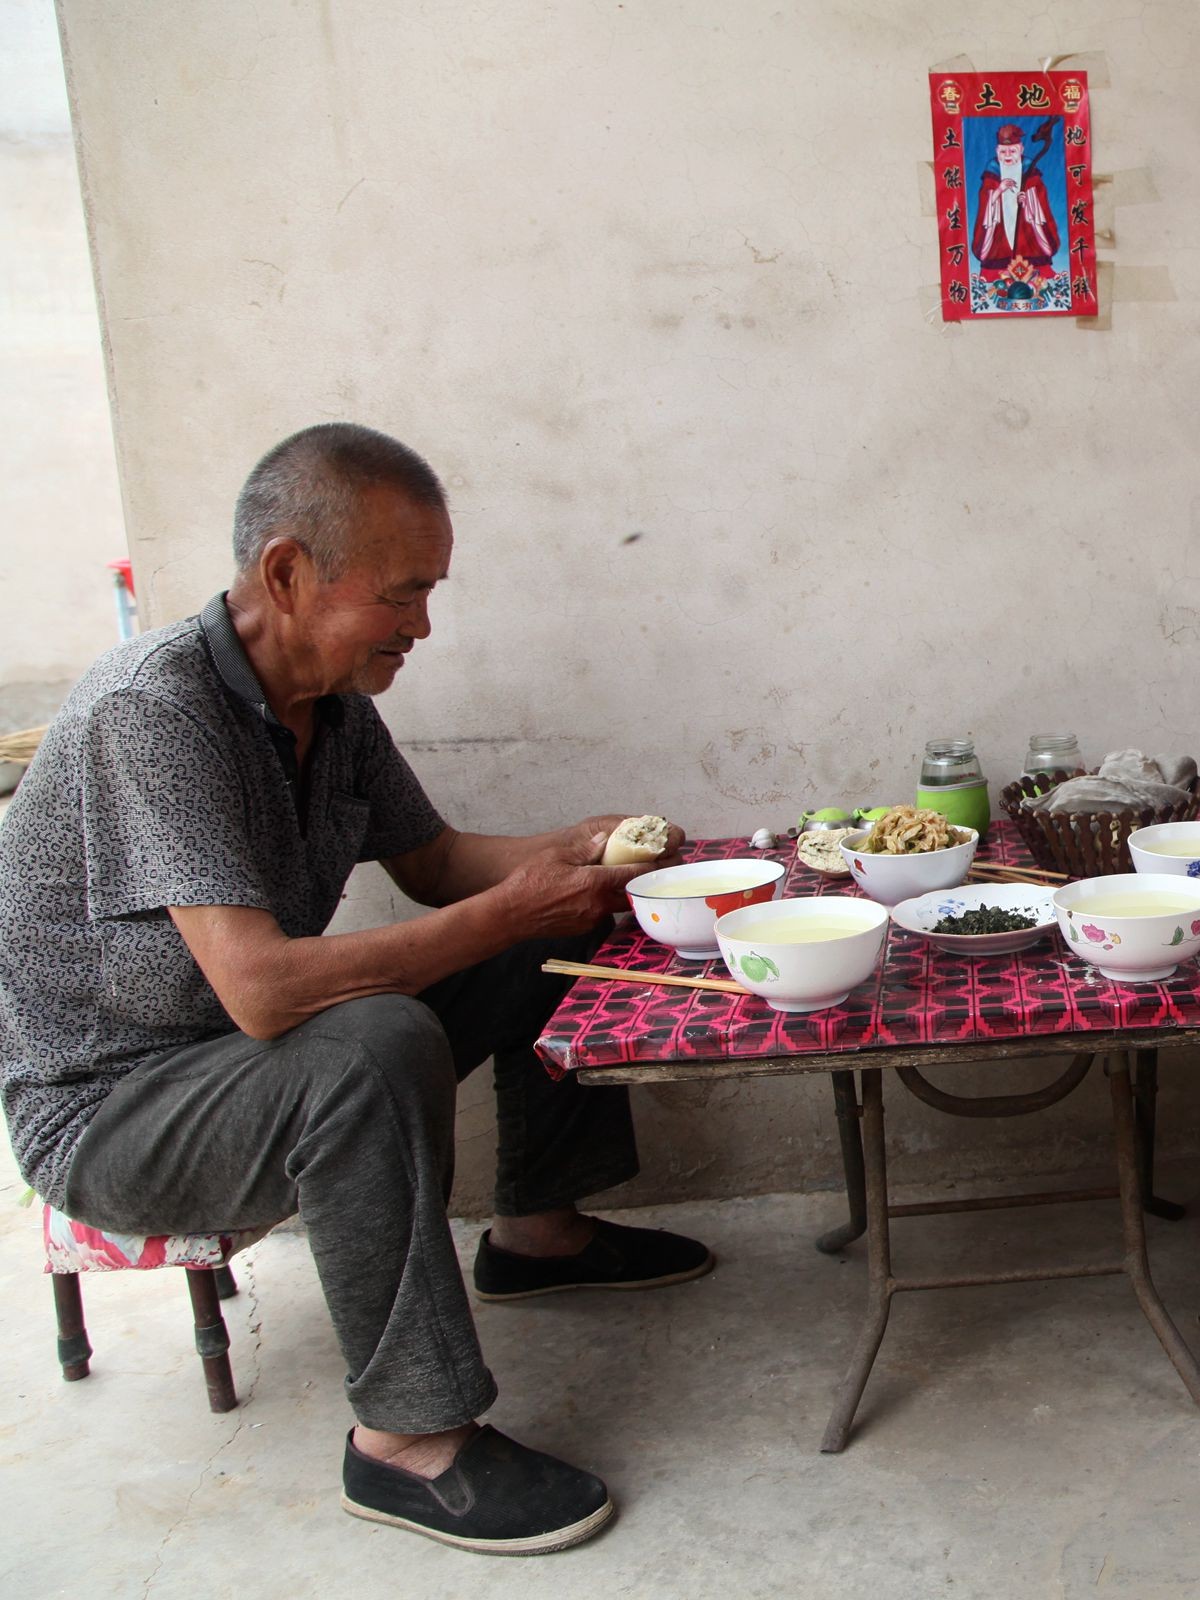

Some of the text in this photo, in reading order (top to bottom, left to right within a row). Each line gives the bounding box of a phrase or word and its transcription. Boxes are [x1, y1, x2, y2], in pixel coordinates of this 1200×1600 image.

[941, 86, 961, 102] 春
[975, 83, 1050, 111] 土地
[1063, 85, 1082, 100] 福
[942, 127, 969, 305] 土能生万物
